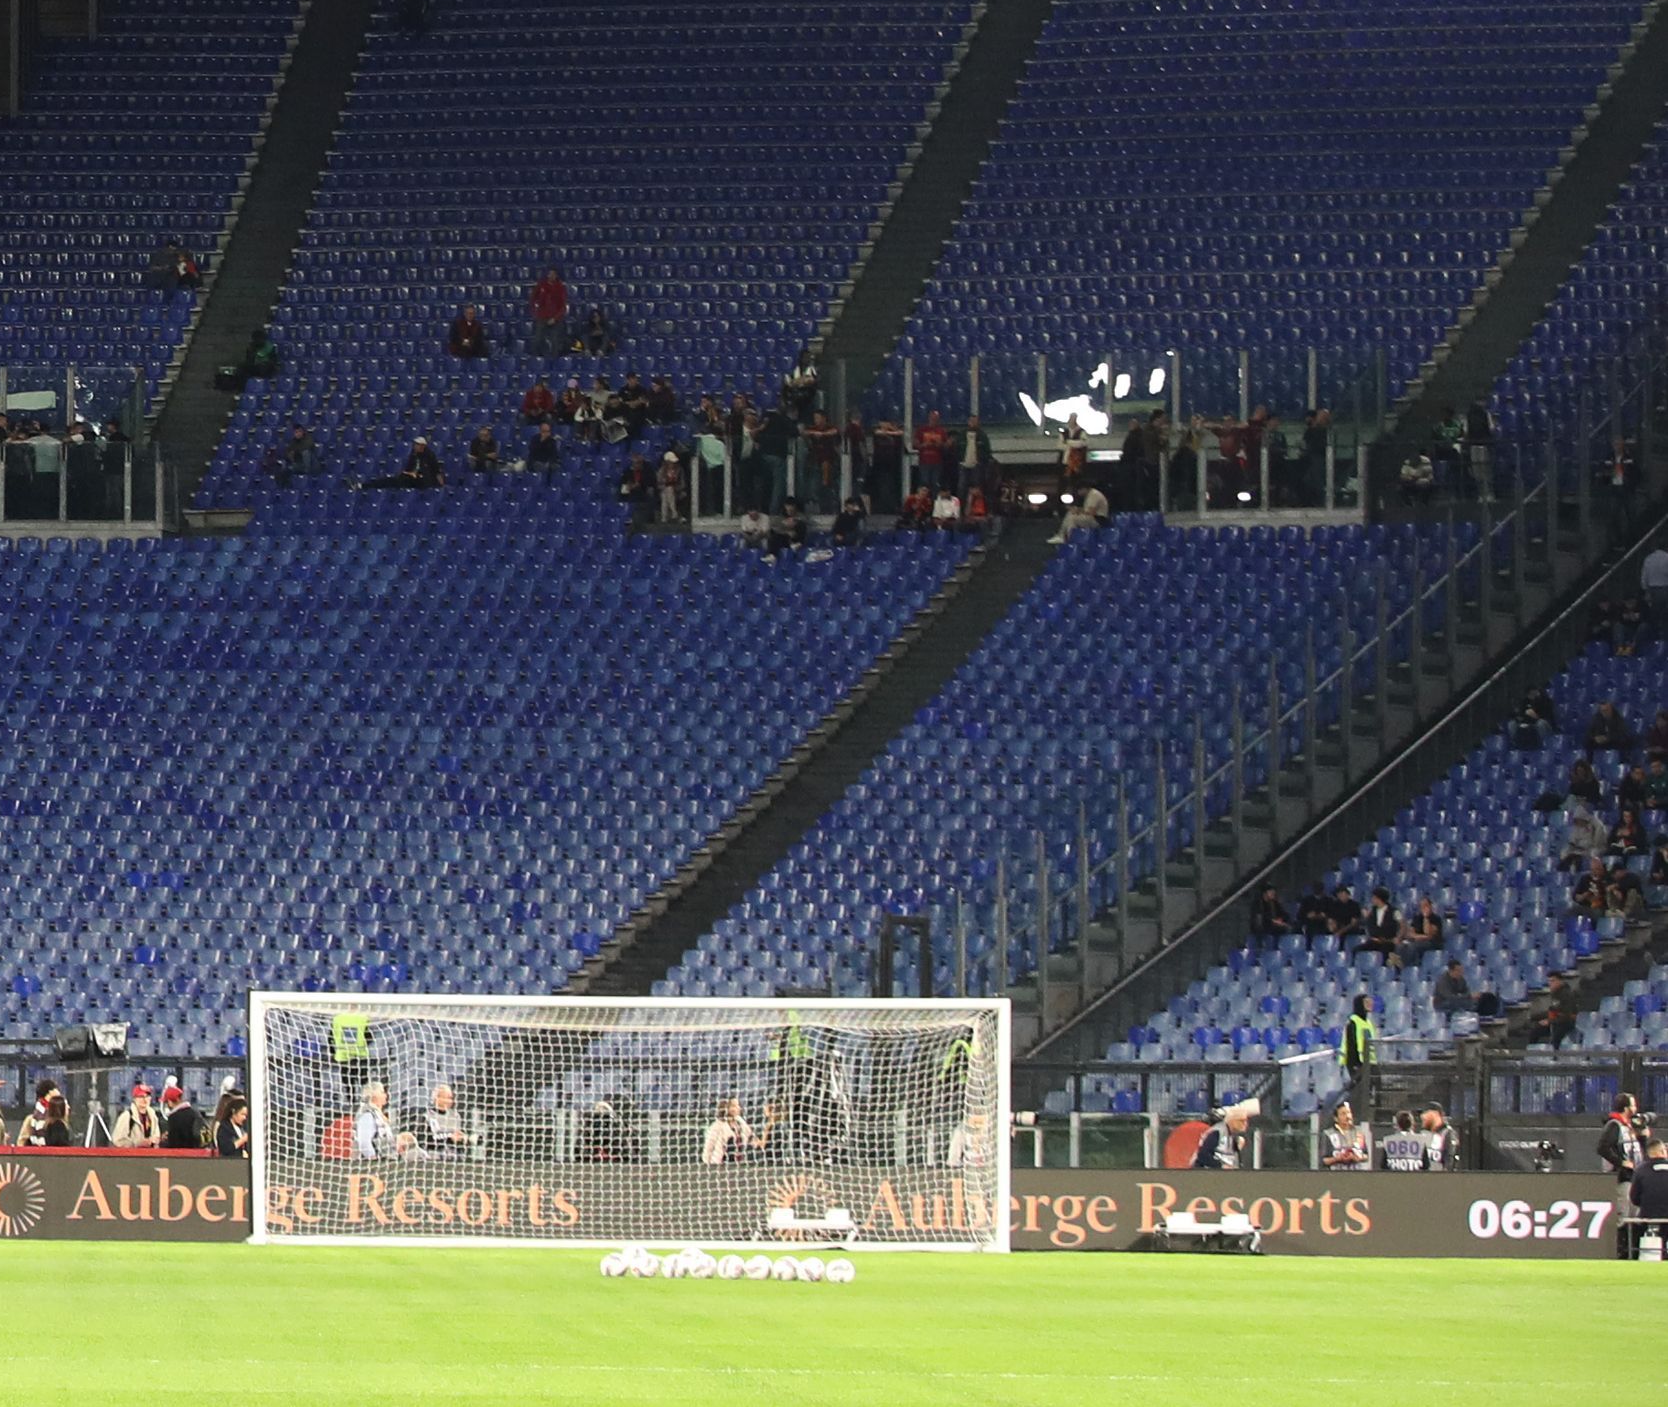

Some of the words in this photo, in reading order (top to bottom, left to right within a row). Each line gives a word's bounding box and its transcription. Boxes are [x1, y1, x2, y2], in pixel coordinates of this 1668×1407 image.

[1387, 1141, 1420, 1155] 060
[344, 1174, 581, 1227] Resorts
[1468, 1200, 1613, 1238] 06:27
